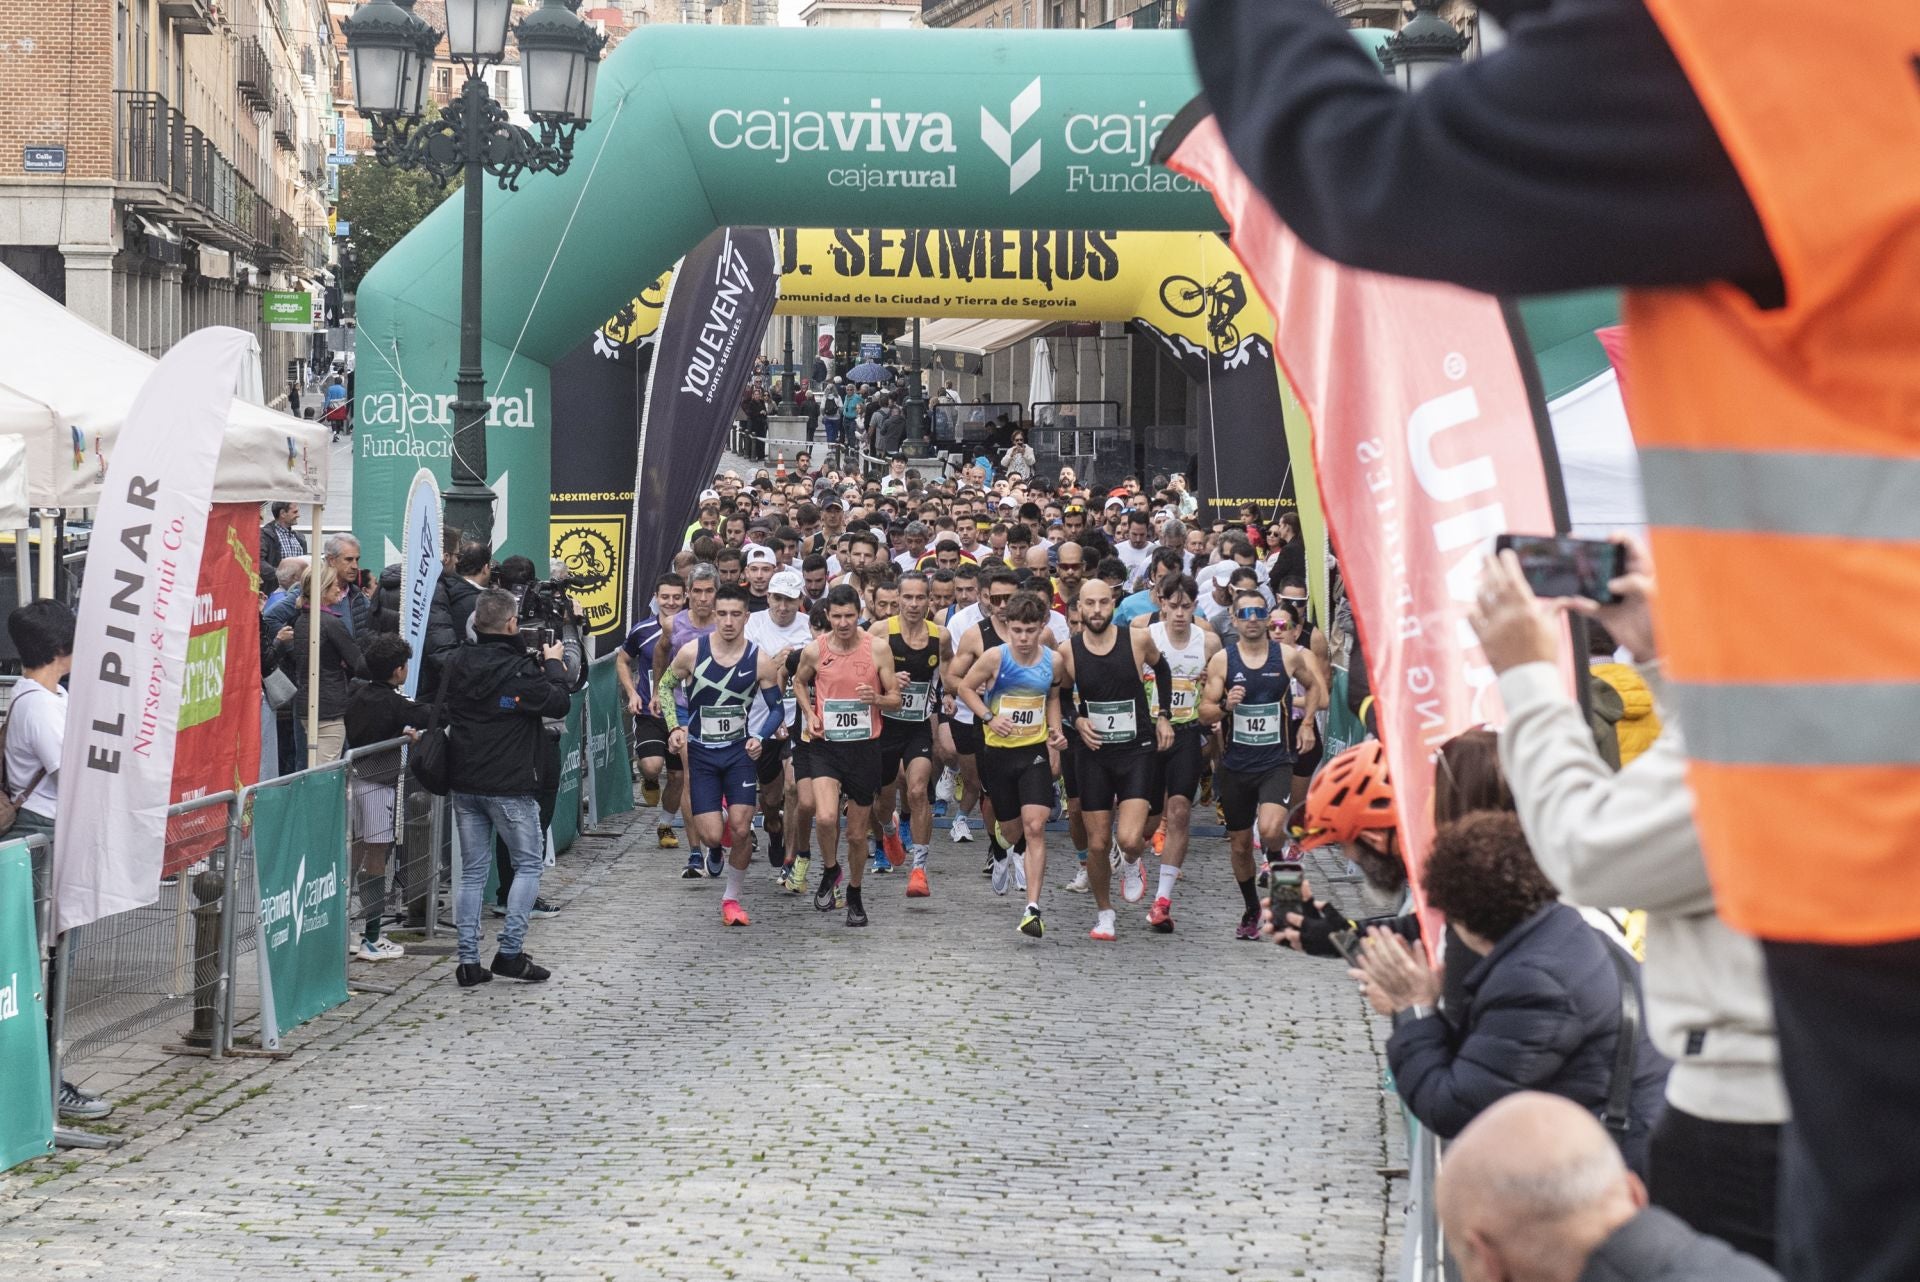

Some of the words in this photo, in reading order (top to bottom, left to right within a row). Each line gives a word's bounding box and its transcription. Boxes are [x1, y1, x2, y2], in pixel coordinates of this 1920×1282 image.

[709, 98, 957, 163] cajaviva
[827, 164, 957, 192] cajarural
[779, 292, 850, 304] omunidad
[854, 294, 871, 304] de
[875, 294, 888, 304] la
[891, 294, 940, 305] Ciudad
[943, 297, 952, 307] y
[955, 295, 998, 306] Tierra
[1001, 296, 1018, 307] de
[1022, 296, 1077, 308] Segovia
[681, 349, 716, 398] YOU
[706, 359, 725, 404] SPORTS
[720, 317, 742, 365] SERVICES
[362, 388, 535, 433] cajarral
[163, 514, 185, 551] Co.
[100, 475, 160, 687] PINAR
[153, 558, 178, 621] Fruit
[150, 628, 165, 651] &
[132, 657, 168, 758] Nursery
[1172, 691, 1185, 706] 31
[717, 718, 730, 732] 18
[836, 712, 858, 727] 206
[1012, 710, 1034, 725] 640
[1107, 715, 1115, 730] 2
[1246, 718, 1266, 732] 142
[87, 712, 125, 774] EL
